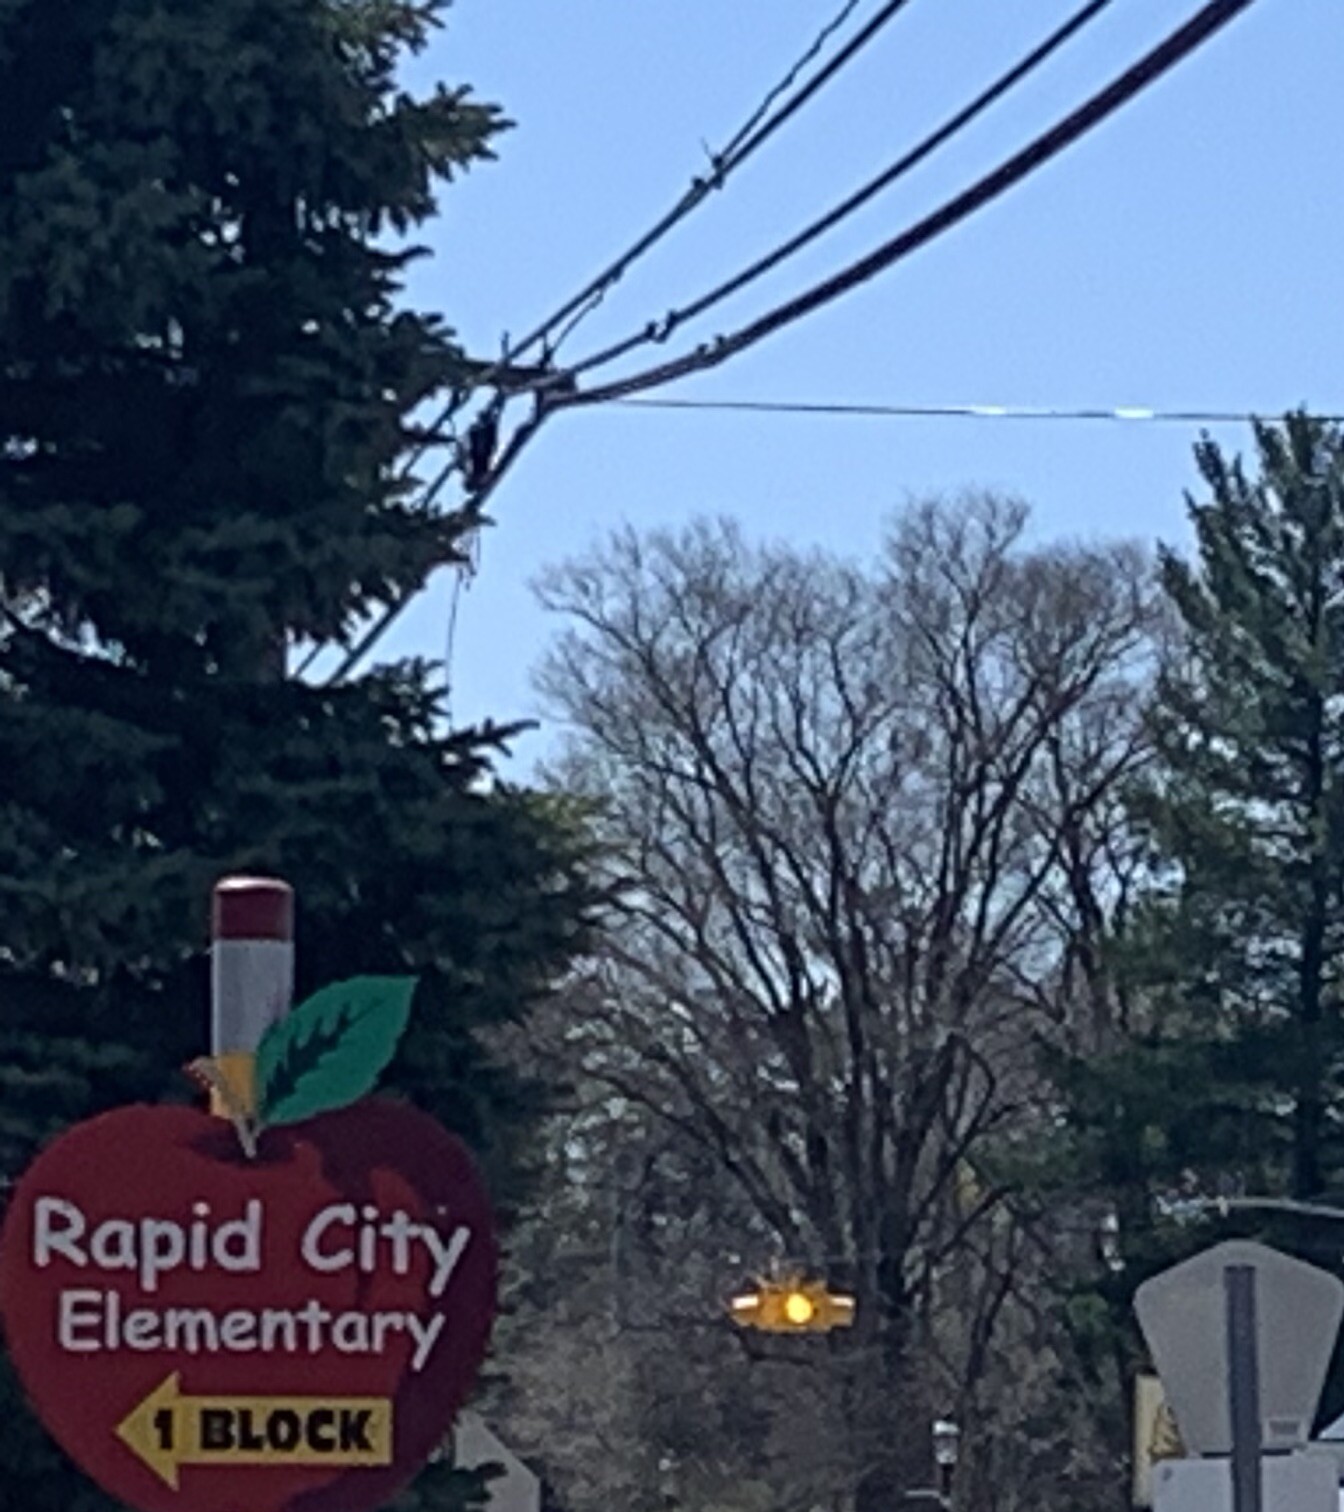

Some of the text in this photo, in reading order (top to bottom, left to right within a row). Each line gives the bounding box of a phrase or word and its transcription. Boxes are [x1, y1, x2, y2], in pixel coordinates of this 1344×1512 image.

[33, 1195, 472, 1296] Rapid City
[58, 1289, 446, 1371] Elementary
[154, 1408, 375, 1451] 1 BLOCK
